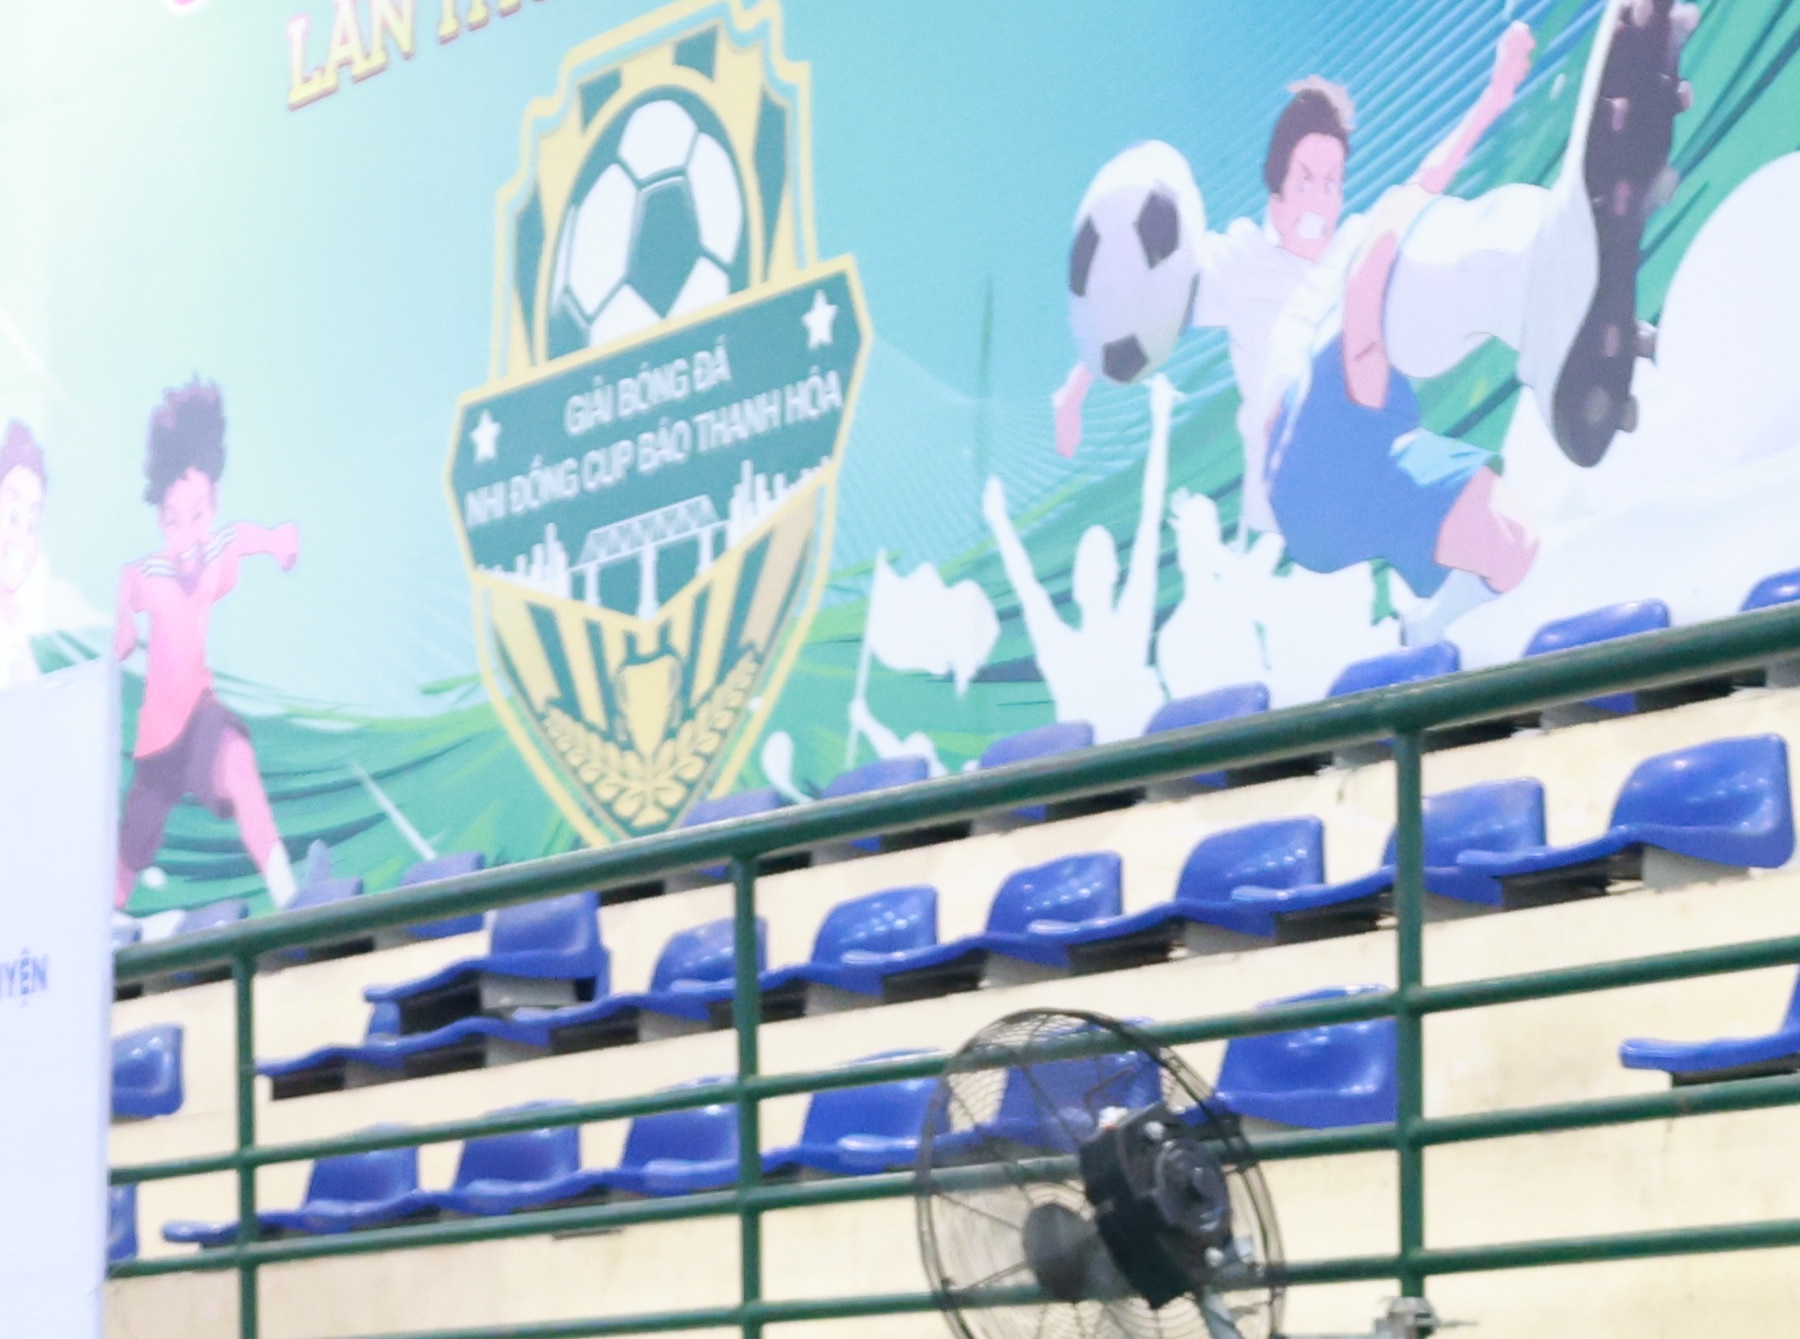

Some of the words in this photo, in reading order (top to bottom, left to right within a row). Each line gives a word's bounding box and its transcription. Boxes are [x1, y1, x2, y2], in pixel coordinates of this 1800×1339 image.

[616, 361, 689, 417] BÓNG
[691, 334, 732, 392] ĐÁ
[465, 480, 507, 526] NHI
[581, 440, 635, 490] CUP
[636, 417, 692, 473] BÁO
[694, 389, 781, 452] THANH
